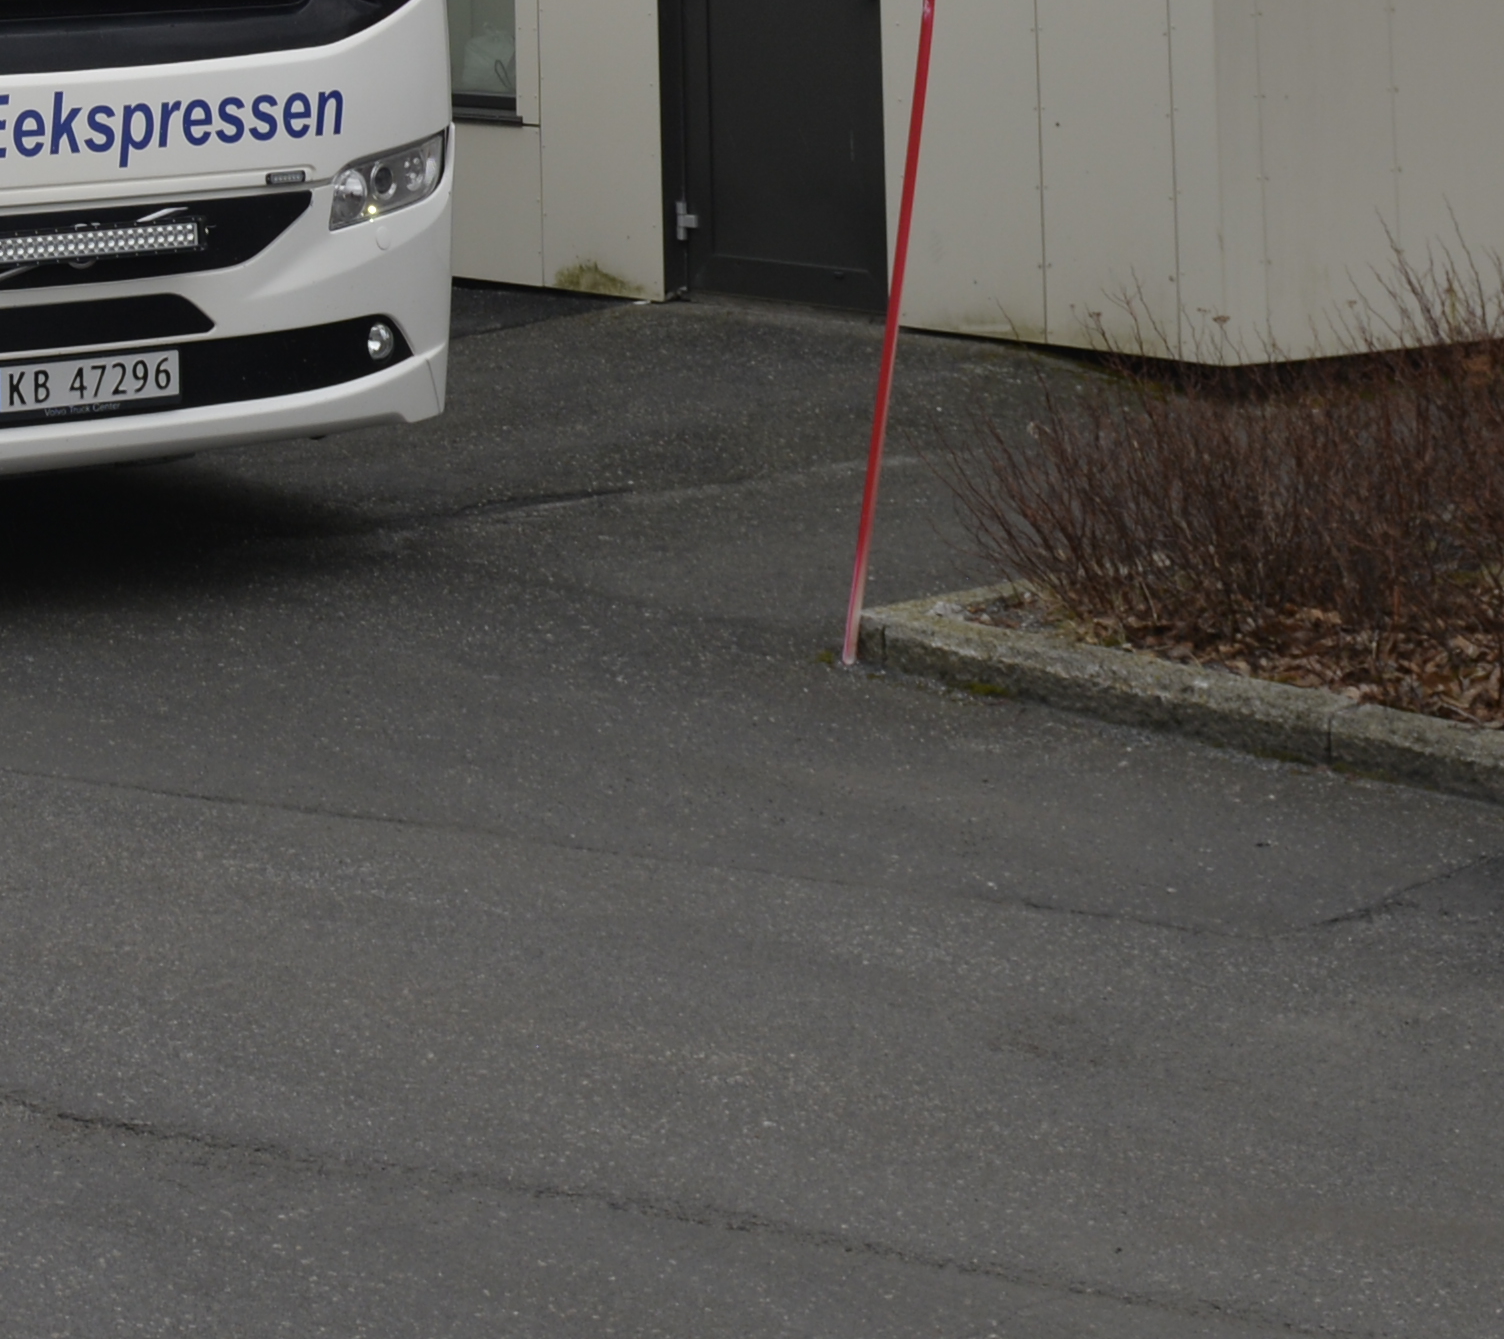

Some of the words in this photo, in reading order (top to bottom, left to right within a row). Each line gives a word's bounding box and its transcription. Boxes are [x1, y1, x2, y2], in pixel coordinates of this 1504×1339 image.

[8, 369, 51, 406] KB
[69, 356, 172, 400] 47296
[44, 408, 67, 417] Volvo
[69, 404, 90, 414] Truck
[92, 402, 121, 413] Center
